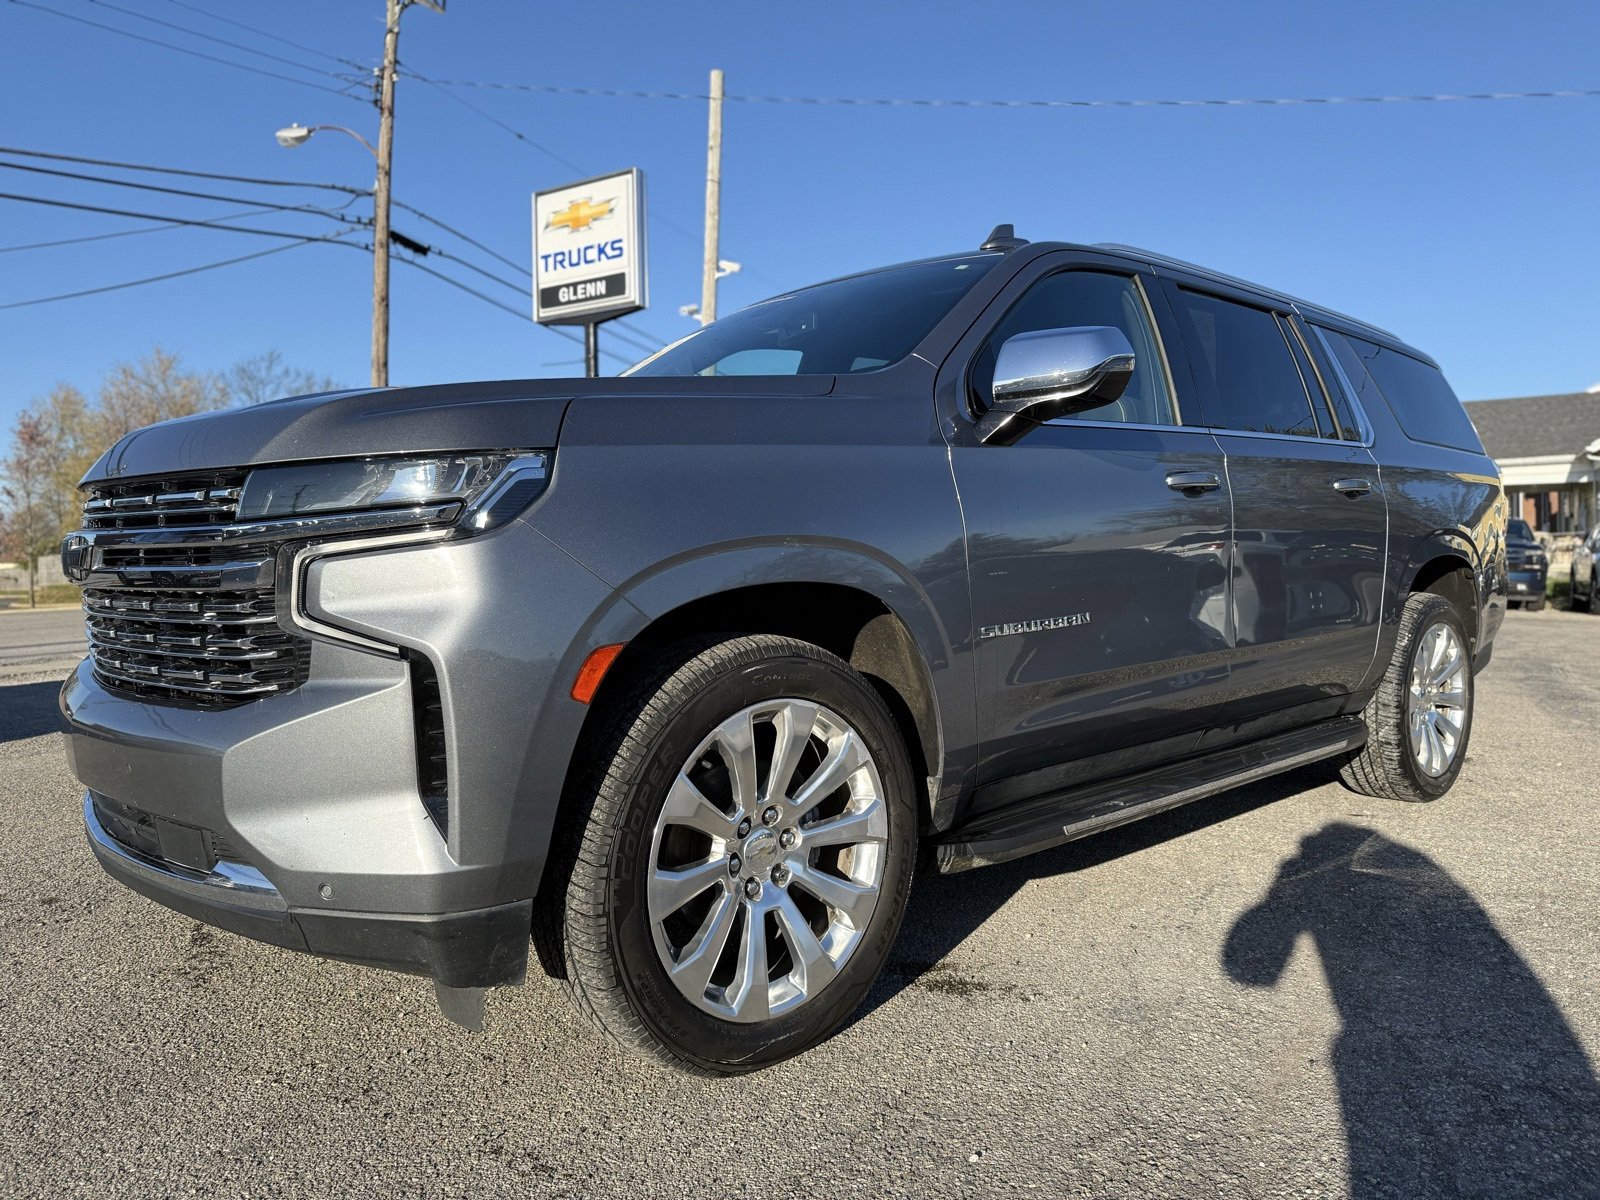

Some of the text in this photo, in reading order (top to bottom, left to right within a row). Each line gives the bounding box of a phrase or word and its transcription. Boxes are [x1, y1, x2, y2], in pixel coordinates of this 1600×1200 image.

[540, 238, 624, 272] TRUCKS
[558, 279, 607, 303] GLENN
[980, 611, 1091, 639] SUBURBAN
[620, 740, 676, 881] COOPER
